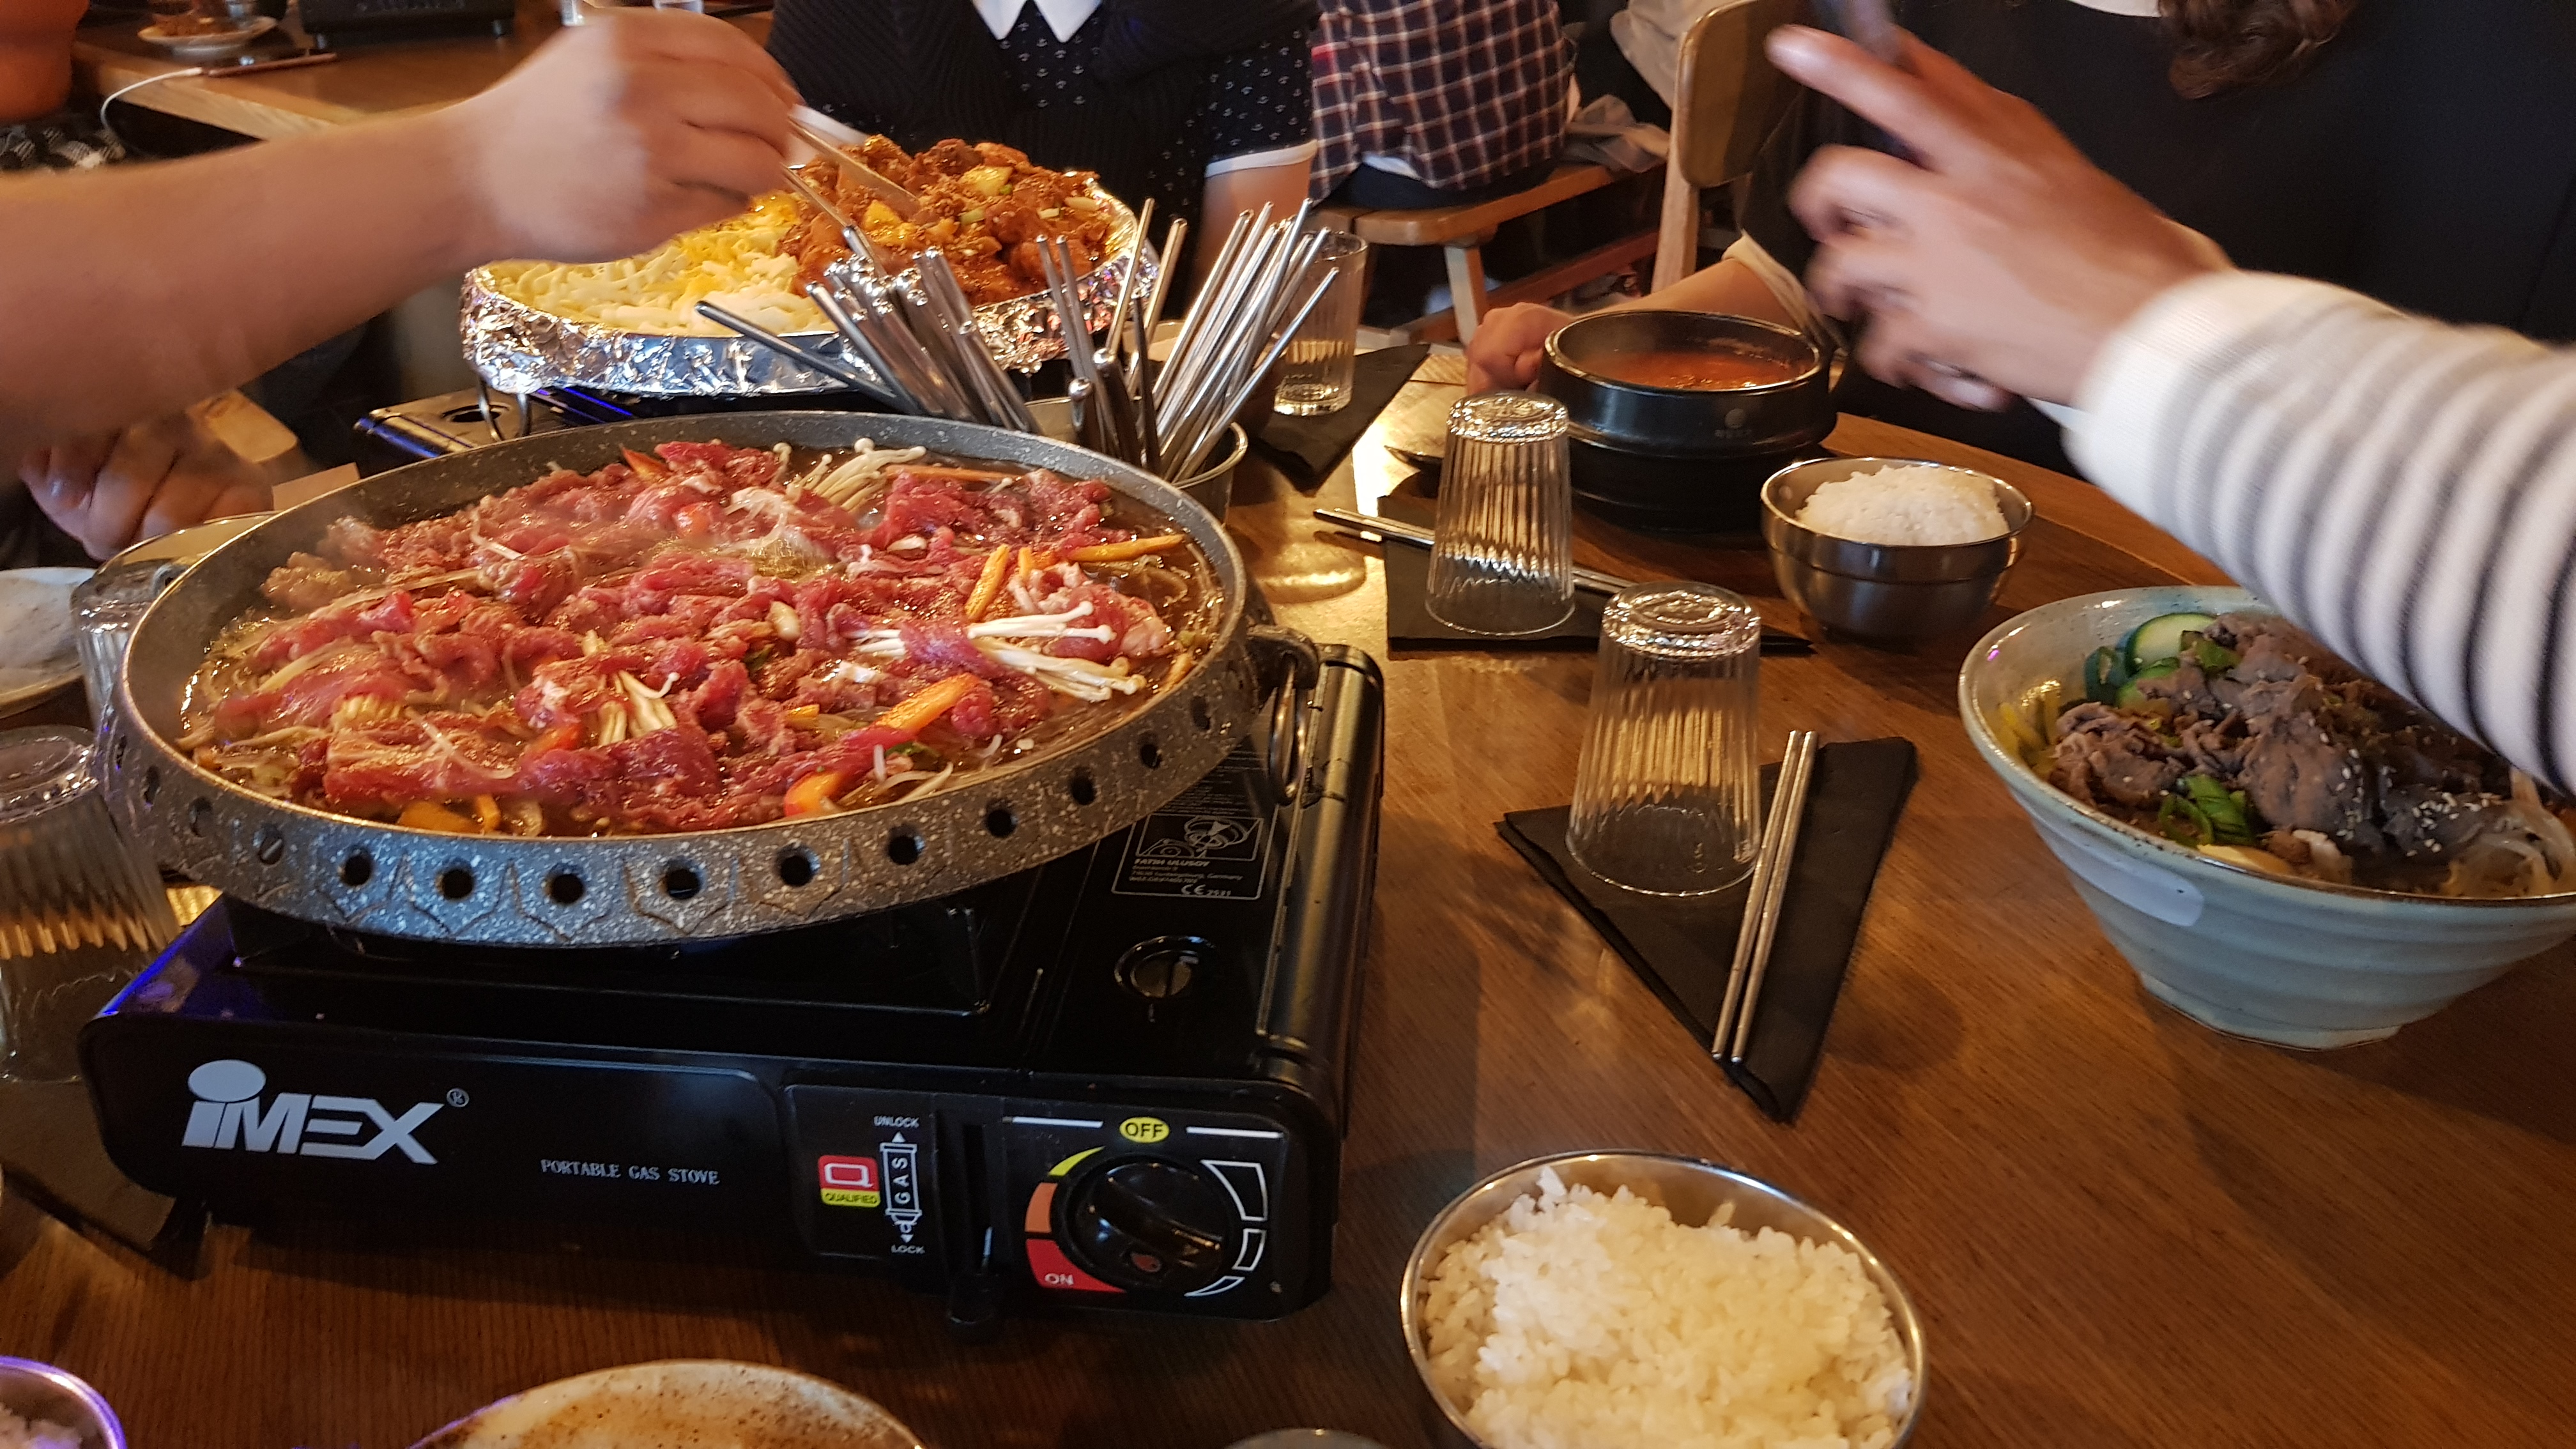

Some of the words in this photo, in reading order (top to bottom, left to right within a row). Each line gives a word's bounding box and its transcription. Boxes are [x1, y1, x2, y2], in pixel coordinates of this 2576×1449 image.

[873, 1115, 920, 1128] UNLOCK
[1125, 1122, 1163, 1138] OFF
[540, 1158, 622, 1178] PORTABLE
[628, 1165, 661, 1181] GAS
[667, 1167, 721, 1186] STOVE
[891, 1156, 911, 1205] GAS
[825, 1192, 878, 1204] QUALIFIED
[891, 1244, 926, 1255] LOCK
[1044, 1273, 1075, 1285] ON
